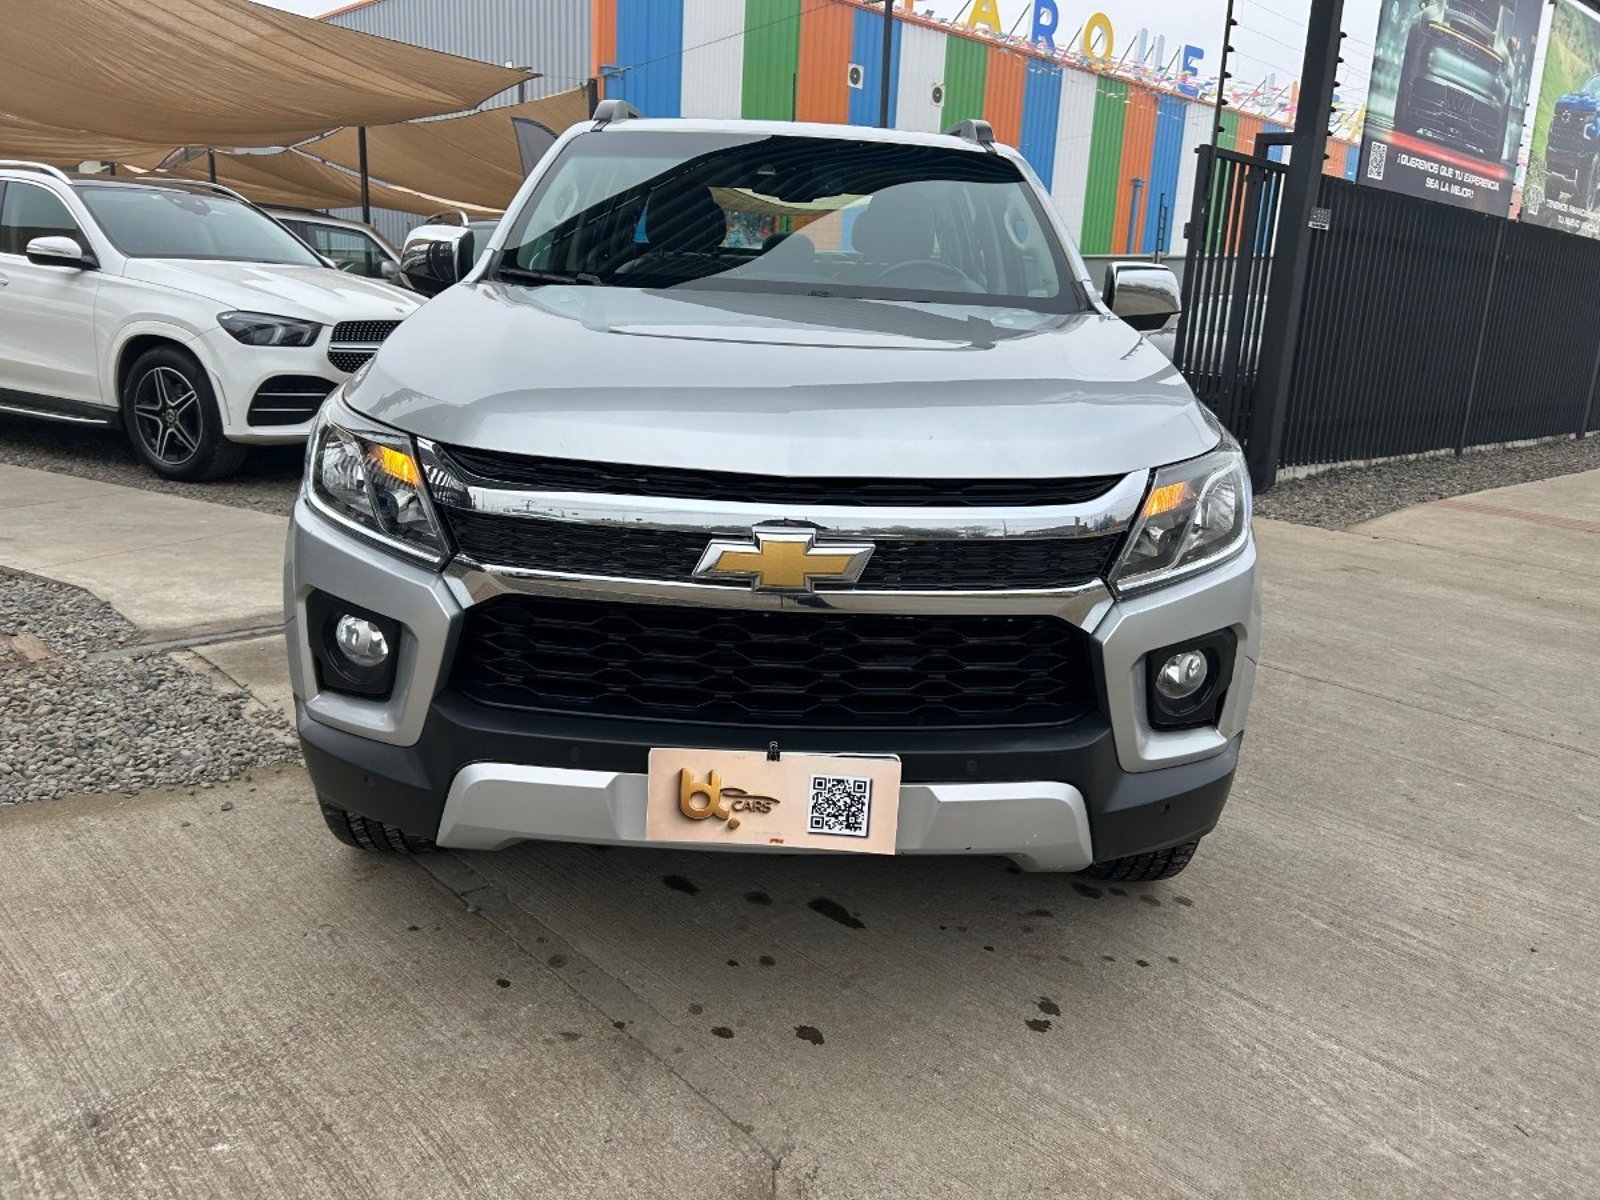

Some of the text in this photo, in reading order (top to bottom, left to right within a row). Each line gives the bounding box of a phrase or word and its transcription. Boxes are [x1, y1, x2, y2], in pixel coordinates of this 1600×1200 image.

[1425, 177, 1475, 199] SEA LA MEJOR!
[1440, 165, 1454, 178] QUE
[1455, 170, 1463, 180] TU
[1463, 173, 1500, 191] EXPERIENCIA
[732, 800, 772, 813] CARS
